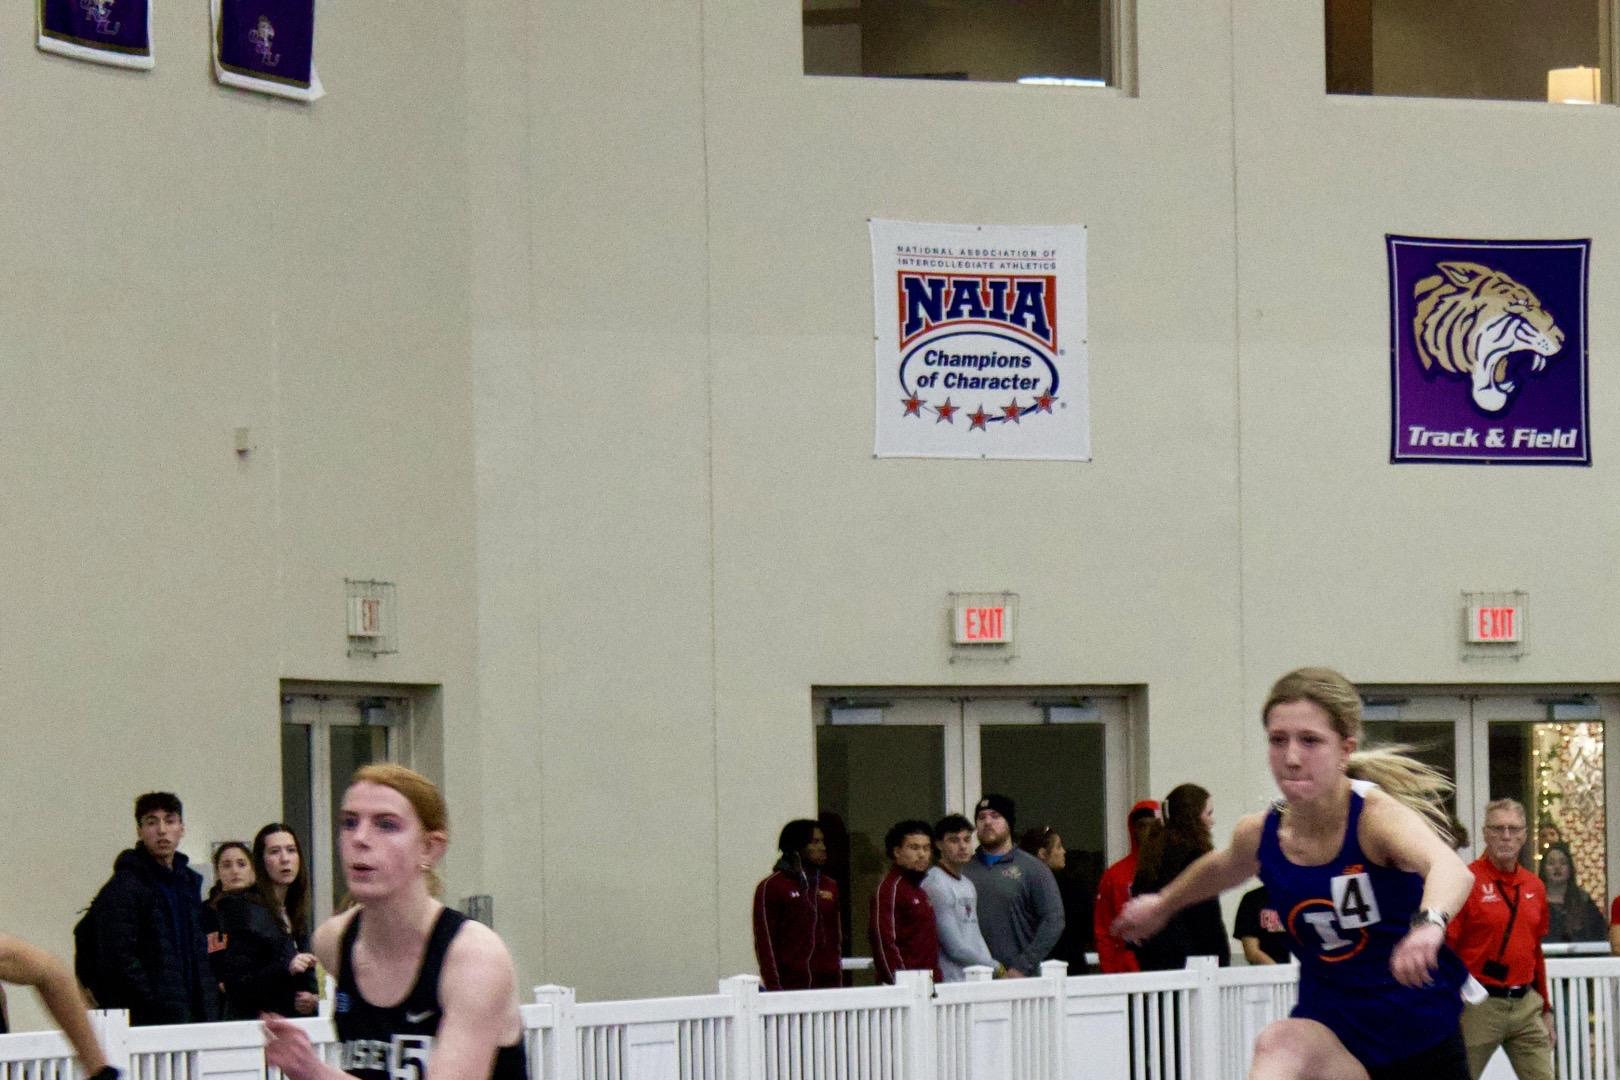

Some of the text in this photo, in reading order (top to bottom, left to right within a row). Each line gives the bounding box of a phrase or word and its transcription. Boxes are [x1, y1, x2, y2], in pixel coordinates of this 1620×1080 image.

[897, 245, 1057, 258] NATIONAL ASSOCIATION OF
[897, 258, 1056, 270] INTERCOLLEGIATE ATHLETICS
[904, 276, 1051, 342] NAIA
[924, 349, 1032, 371] Champions
[916, 371, 1041, 391] of Character
[1408, 426, 1578, 449] Track & Field
[965, 607, 1004, 640] EXIT
[1479, 607, 1514, 640] EXIT
[1340, 877, 1371, 922] 4
